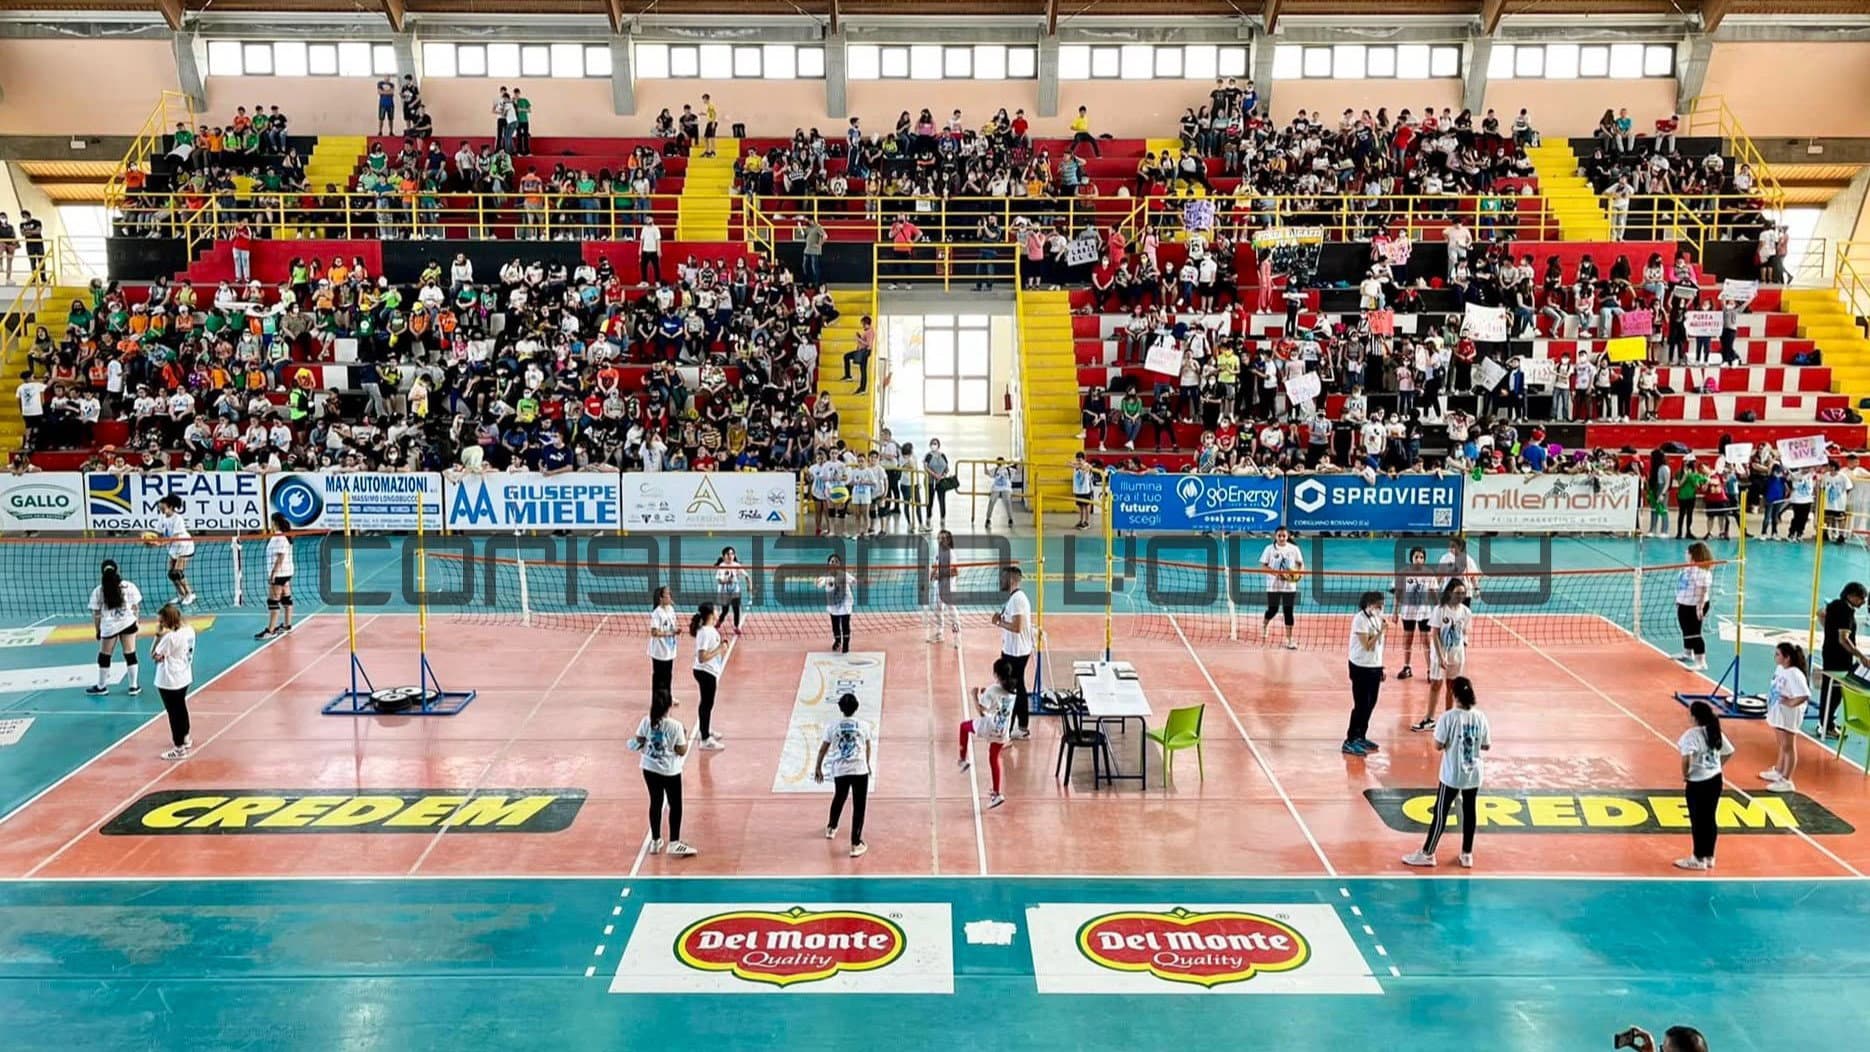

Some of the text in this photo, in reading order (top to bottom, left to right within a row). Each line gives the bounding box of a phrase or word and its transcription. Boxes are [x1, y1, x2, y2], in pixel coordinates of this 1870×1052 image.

[141, 474, 257, 495] REALE
[325, 476, 428, 493] MAX AUTOMAZIONI
[504, 486, 616, 499] GIUSEPPE
[11, 495, 70, 507] GALLO
[1206, 485, 1279, 507] goEnergy
[1332, 487, 1453, 505] SPROVIERI
[505, 501, 617, 524] MIELE
[1120, 503, 1159, 513] futuro
[195, 519, 261, 528] POLINO
[1128, 514, 1161, 525] scegli
[141, 795, 558, 828] CREDEM
[1402, 795, 1800, 828] CREDEM
[697, 930, 889, 950] Del Monte
[1097, 932, 1291, 951] Del Monte
[742, 951, 833, 969] Quality
[1152, 952, 1244, 970] Quality
